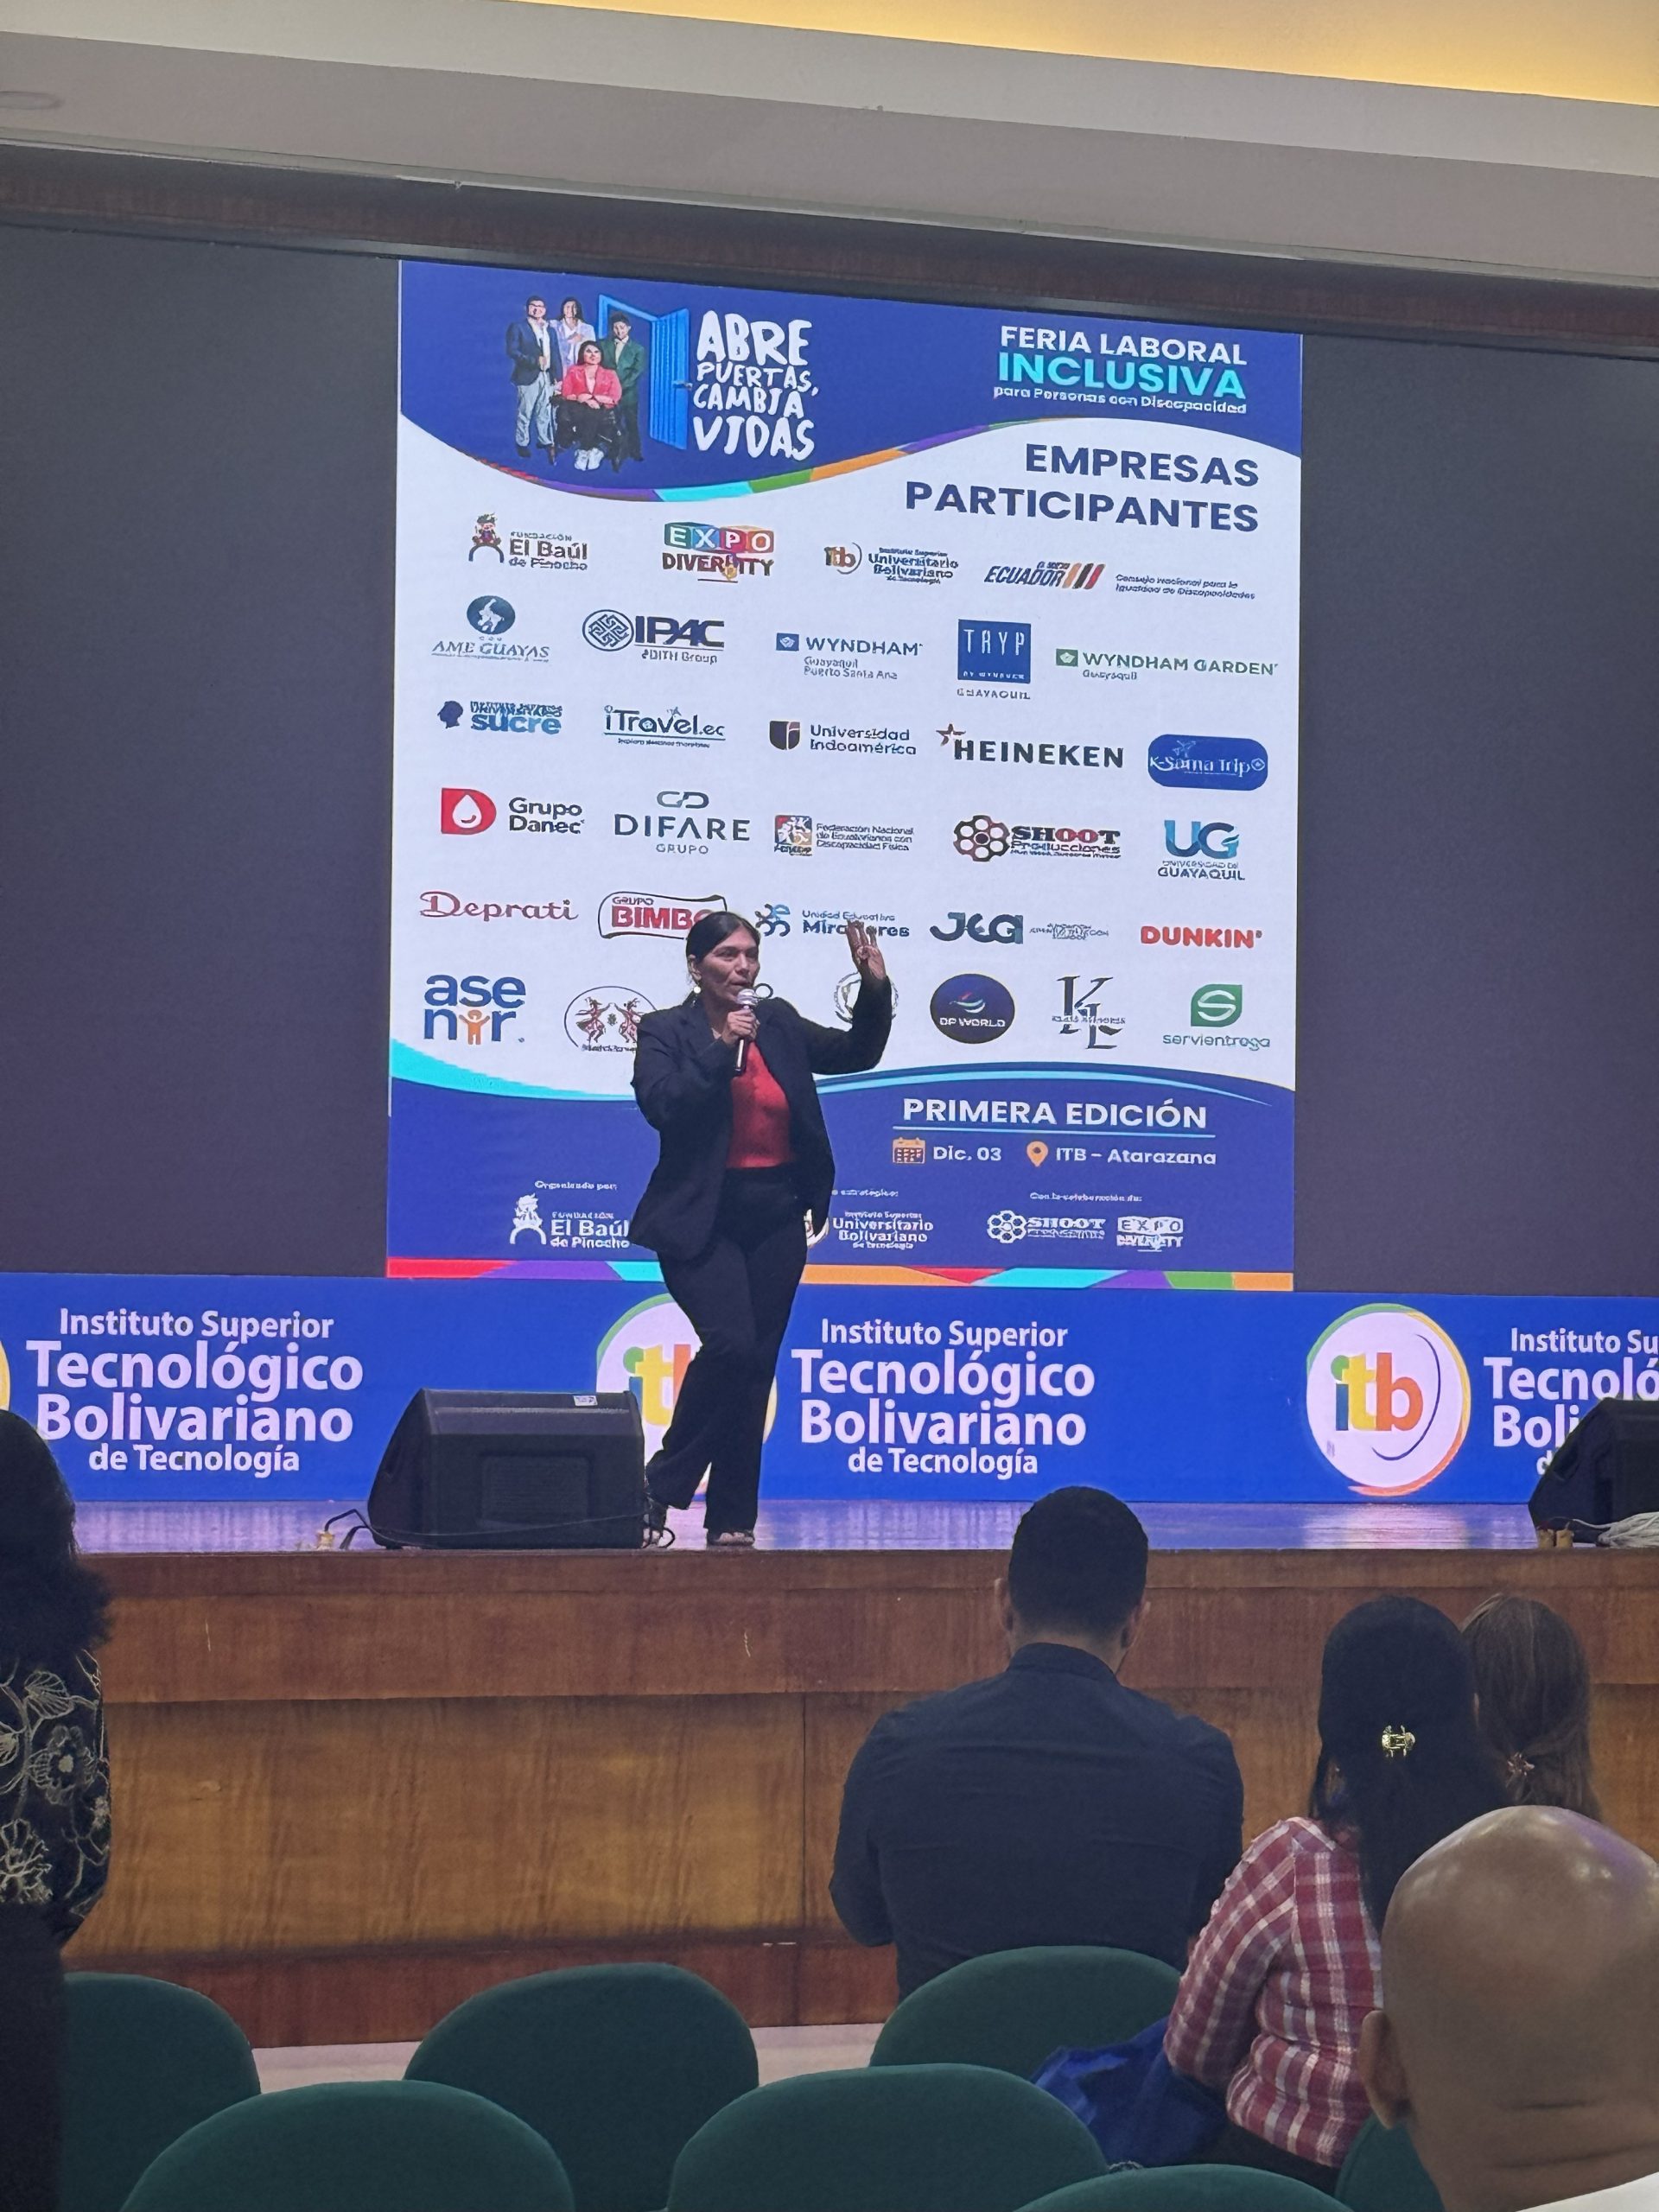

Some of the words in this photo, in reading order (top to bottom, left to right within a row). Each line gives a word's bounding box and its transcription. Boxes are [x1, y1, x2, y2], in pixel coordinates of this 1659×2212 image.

[696, 310, 812, 366] ABRE
[1001, 325, 1091, 354] FERIA
[1100, 334, 1248, 365] LABORAL
[696, 361, 820, 397] PUERTAS,
[998, 352, 1247, 399] INCLUSIVA
[694, 384, 804, 418] CAMBIA
[994, 386, 1030, 400] para
[1033, 388, 1106, 404] Personas
[1109, 397, 1137, 407] con
[1141, 396, 1247, 414] Discapacidad
[693, 415, 815, 461] VIDAS
[1026, 443, 1259, 487] EMPRESAS
[906, 481, 1259, 532] PARTICIPANTES
[510, 538, 530, 556] El
[537, 540, 588, 560] Baúl
[670, 526, 771, 551] EXPO
[984, 566, 1065, 588] ECUADOR
[634, 614, 724, 648] IPAC
[963, 629, 1025, 656] TRYP
[480, 642, 550, 658] GUAYAS
[806, 637, 918, 656] WYNDHAM
[1083, 652, 1188, 671] WYNDHAM
[1193, 659, 1274, 676] GARDEN
[471, 714, 562, 734] sucre
[810, 724, 910, 741] Universidad
[810, 739, 917, 755] Indoamérica
[954, 739, 1123, 768] HEINEKEN
[509, 797, 582, 820] Grupo
[509, 815, 581, 835] Danec
[613, 813, 751, 842] DIFARE
[1011, 826, 1121, 844] SHOOT
[1164, 819, 1239, 860] UG
[656, 843, 709, 855] GRUPO
[1158, 867, 1245, 880] GUAYAQUIL
[419, 891, 579, 922] Deprati
[424, 975, 526, 1008] ase
[939, 1017, 957, 1026] DP
[958, 1018, 1006, 1027] WORLD
[1162, 1033, 1270, 1052] servientrega
[903, 1098, 1058, 1126] PRIMERA
[1065, 1098, 1207, 1128] EDICIÓN
[932, 1145, 972, 1161] Dic.
[977, 1147, 1001, 1161] 03
[1056, 1147, 1087, 1161] ITB
[1107, 1148, 1217, 1166] Atarazana
[551, 1219, 571, 1236] El
[579, 1219, 629, 1237] Baúl
[1027, 1217, 1106, 1230] SHOOT
[1122, 1220, 1182, 1232] EXPO
[60, 1308, 194, 1336] Instituto
[201, 1310, 334, 1344] Superior
[821, 1318, 943, 1346] Instituto
[949, 1319, 1069, 1354] Superior
[1511, 1328, 1621, 1354] Instituto
[1627, 1329, 1659, 1354] Su
[26, 1339, 364, 1402] Tecnológico
[791, 1348, 1096, 1408] Tecnológico
[1484, 1357, 1659, 1401] Tecnoló
[1331, 1352, 1424, 1432] itb
[36, 1391, 353, 1443] Bolivariano
[801, 1398, 1087, 1446] Bolivariano
[1493, 1404, 1580, 1447] Boli
[88, 1443, 127, 1471] de
[133, 1443, 300, 1478] Tecnología
[848, 1446, 882, 1473] de
[887, 1446, 1039, 1480] Tecnología
